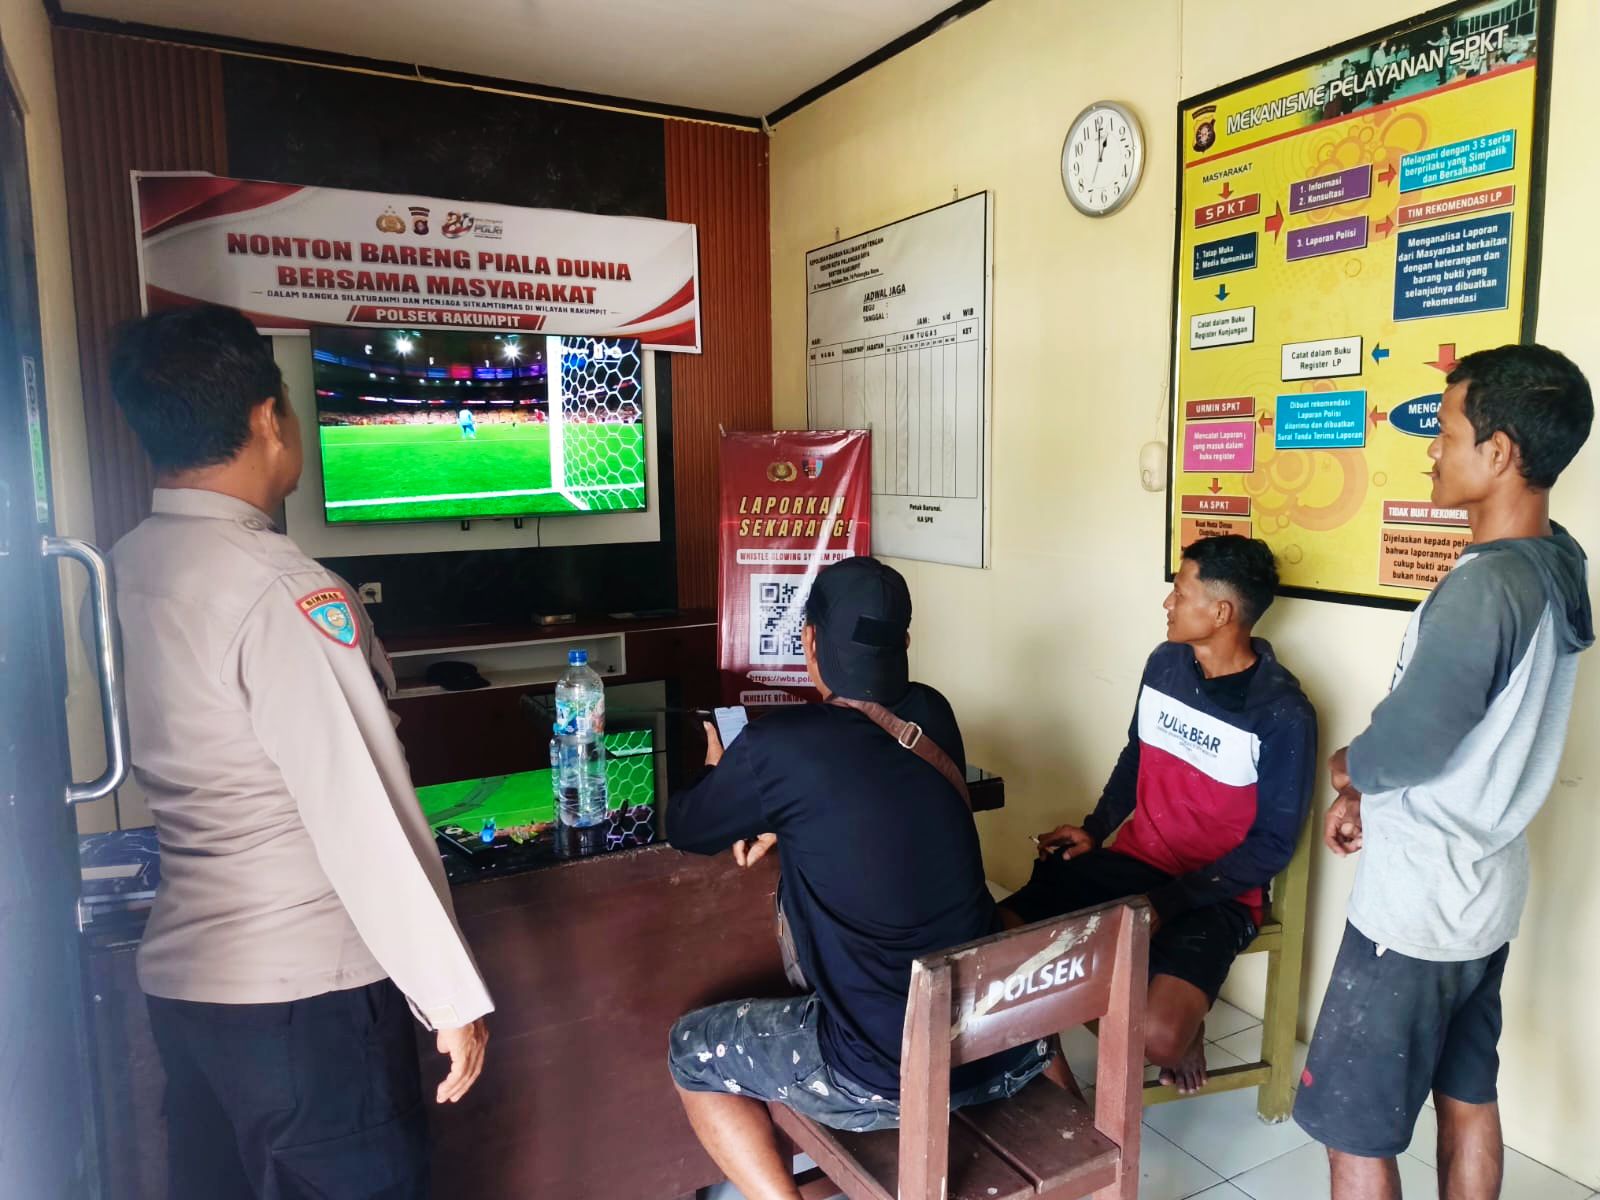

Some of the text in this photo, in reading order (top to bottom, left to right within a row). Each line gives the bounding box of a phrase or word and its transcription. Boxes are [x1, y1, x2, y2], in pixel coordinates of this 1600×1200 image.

[1227, 24, 1509, 135] MEKANISME PELAYANAN SPKT
[1402, 134, 1511, 167] Melayani dengan 3 S serta
[1405, 145, 1507, 177] berprilaku yang Simpatik
[1202, 162, 1253, 184] MASYARAKAT
[1422, 162, 1486, 184] dan Bersahabat
[1308, 176, 1342, 192] Informasi
[1307, 188, 1345, 205] Konsultasi
[1408, 191, 1502, 219] TIM REKOMENDASI LP
[1205, 200, 1247, 221] SPKT
[1306, 233, 1334, 247] Laporan
[1336, 228, 1357, 241] Polisi
[1408, 225, 1498, 248] Menganalisa Laporan
[227, 232, 632, 281] NONTON BARENG PIALA DUNIA
[1398, 237, 1508, 262] dari Masyarakat berkaitan
[1202, 259, 1219, 268] Media
[1220, 251, 1254, 265] Komunikasi
[1403, 251, 1500, 274] dengan keterangan dan
[1413, 266, 1488, 285] barang bukti yang
[277, 265, 597, 305] BERSAMA MASYARAKAT
[863, 284, 906, 303] JADWAL JAGA
[1405, 278, 1498, 299] selanjutnya dibuatkan
[267, 289, 299, 299] DALAM
[302, 292, 339, 301] RANGKA
[341, 294, 400, 304] SILATURAHMI
[402, 296, 420, 305] DAN
[423, 298, 461, 308] MENJAGA
[525, 304, 533, 312] DI
[535, 304, 568, 314] WILAYAH
[570, 307, 607, 316] RAKUMPIT
[1422, 292, 1477, 308] rekomendasi
[376, 308, 521, 328] POLSEK RAKUMPIT
[963, 307, 974, 317] WIB
[1197, 315, 1245, 329] Catat dalam Buku
[1195, 326, 1248, 340] Register Kunjungan
[1291, 346, 1351, 360] Catat dalam Buku
[1300, 358, 1342, 371] Register LP
[1196, 401, 1240, 413] URMIN SPKT
[1289, 398, 1351, 409] Dibuat rekomendasi
[1297, 409, 1341, 420] Laporan Polisi
[1311, 421, 1322, 429] dan
[1324, 420, 1355, 429] dibuatkan
[1278, 431, 1363, 441] Surat Tanda Terima Laporan
[739, 496, 846, 515] LAPORKAN
[1199, 500, 1229, 509] KA SPKT
[1388, 507, 1409, 517] TIDAK
[1383, 533, 1421, 544] Dijelaskan
[1424, 536, 1450, 547] kepada
[740, 552, 769, 561] WHISTLE
[771, 552, 801, 561] LOWING
[1385, 546, 1408, 555] bahwa
[1411, 547, 1452, 560] laporannya
[1393, 560, 1414, 569] cukup
[1416, 561, 1435, 570] bukti
[1393, 571, 1414, 580] bukan
[987, 954, 1087, 1001] POLSEK
